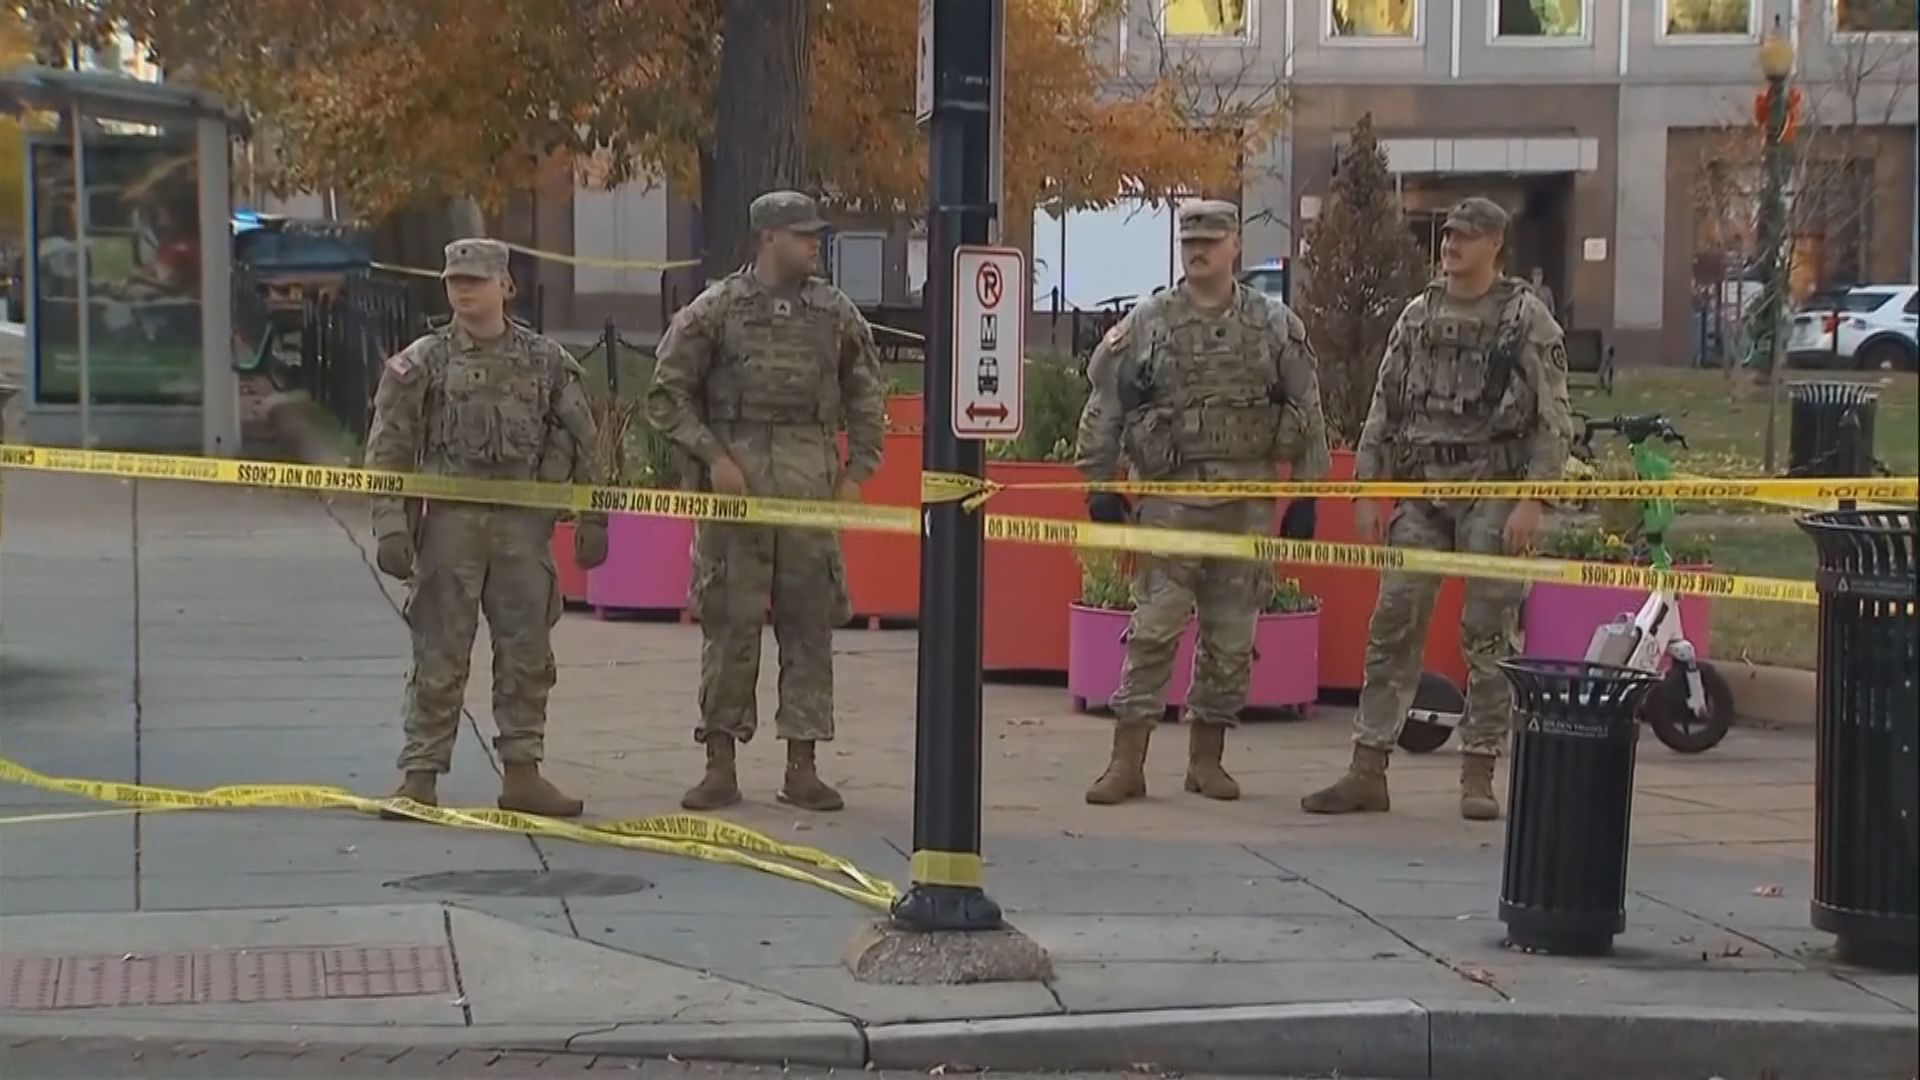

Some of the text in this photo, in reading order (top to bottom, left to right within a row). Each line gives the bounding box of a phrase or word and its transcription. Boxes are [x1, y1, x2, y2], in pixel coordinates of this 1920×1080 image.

[238, 464, 404, 491] CRIME SCENE DO NOT CROSS
[590, 490, 627, 510] CROSS
[630, 492, 652, 512] NOT
[655, 493, 671, 513] DO
[673, 495, 709, 516] SCENE
[712, 498, 748, 518] CRIME
[988, 518, 1078, 540] CRIME SCENE DO
[1254, 541, 1288, 560] CROSS
[1292, 542, 1312, 561] NOT
[1315, 543, 1329, 562] DO
[1333, 545, 1366, 566] SCENE
[1371, 548, 1404, 568] CRIME
[1581, 565, 1735, 594] CRIME SCENE DO NOT CROSS
